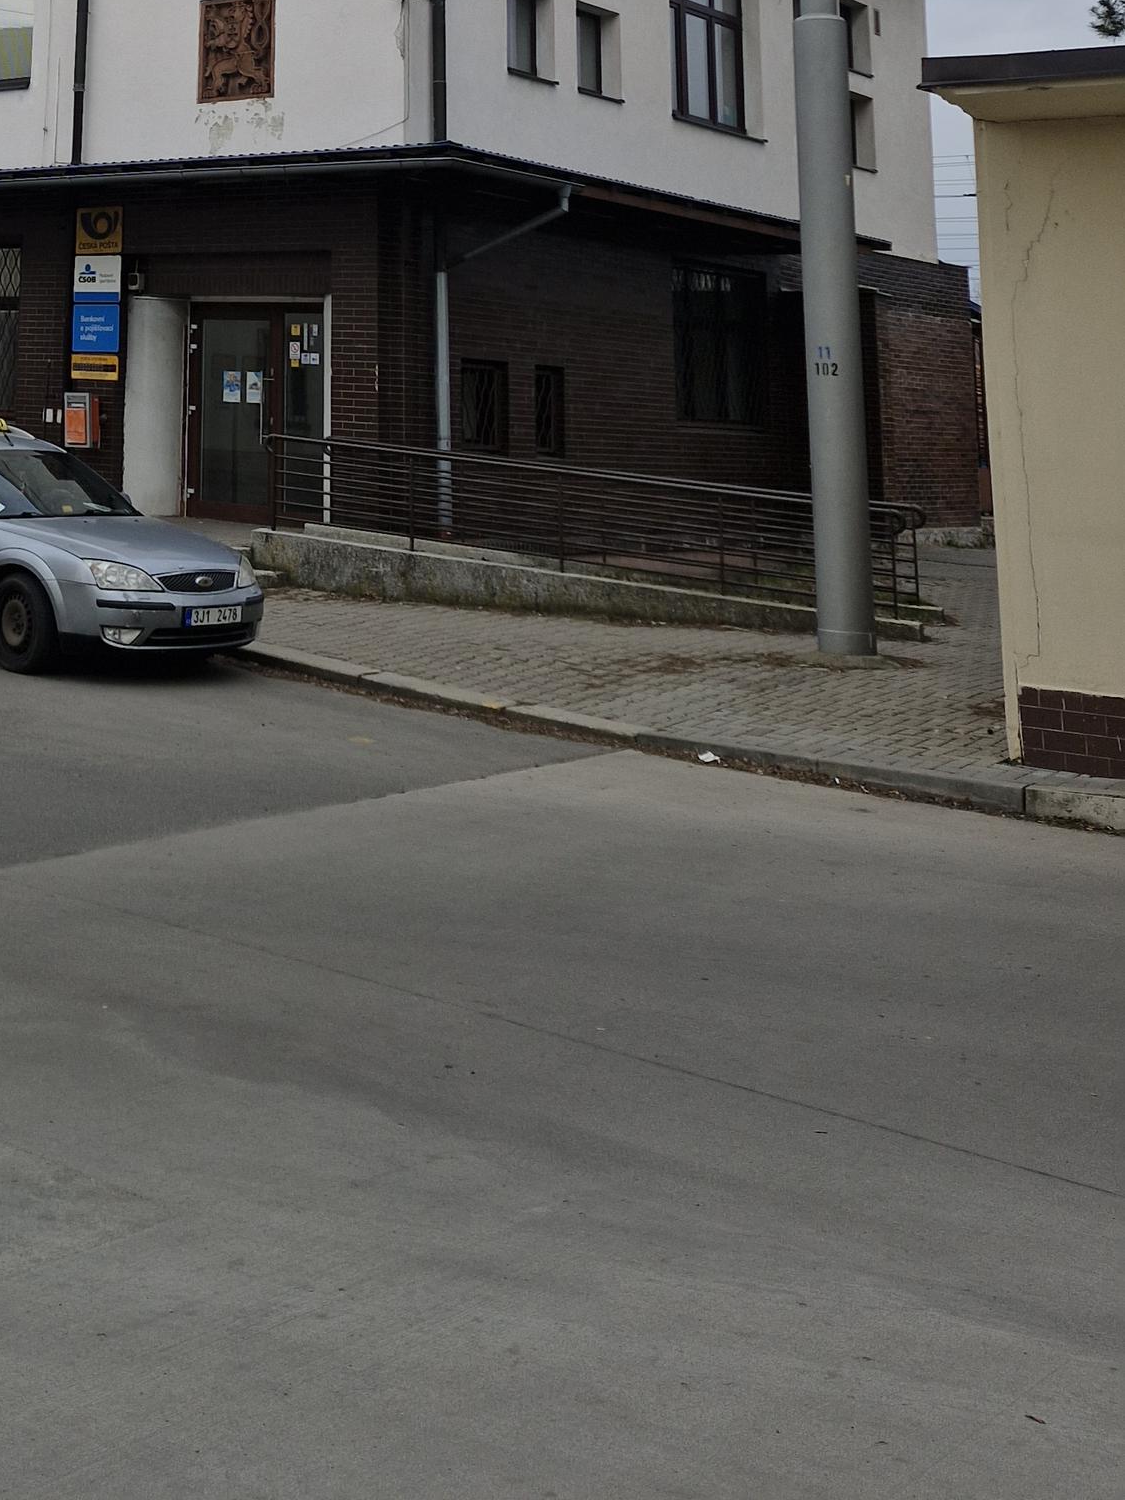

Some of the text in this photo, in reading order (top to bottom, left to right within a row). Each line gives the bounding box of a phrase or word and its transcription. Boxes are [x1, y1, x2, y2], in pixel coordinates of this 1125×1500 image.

[98, 241, 118, 249] POŠTA
[818, 346, 831, 359] 11
[815, 362, 839, 377] 102
[194, 608, 238, 623] 3J1 2478
